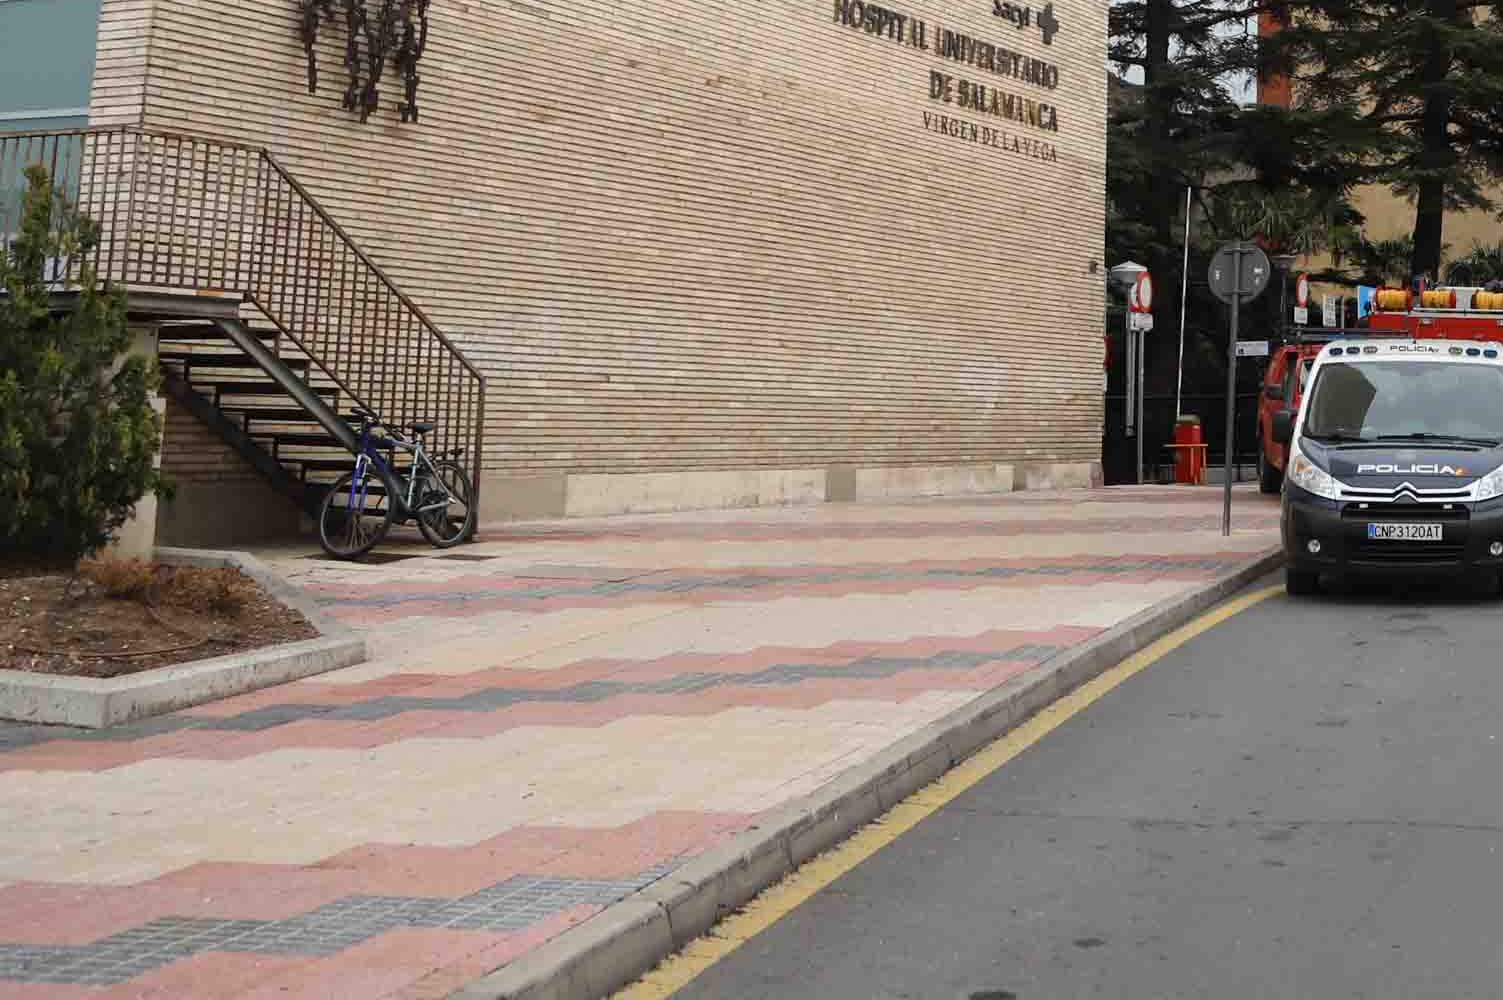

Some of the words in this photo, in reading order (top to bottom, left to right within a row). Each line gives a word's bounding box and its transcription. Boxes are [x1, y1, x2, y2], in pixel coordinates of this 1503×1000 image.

[936, 27, 1058, 89] UNIVERSITARIO
[929, 70, 952, 102] DE
[958, 79, 1058, 131] SALAMANCA
[923, 111, 977, 143] VIRGEN
[982, 125, 1000, 148] DE
[1002, 132, 1020, 153] LA
[1022, 137, 1057, 162] VEGA
[1375, 525, 1441, 538] CNP3120AT
